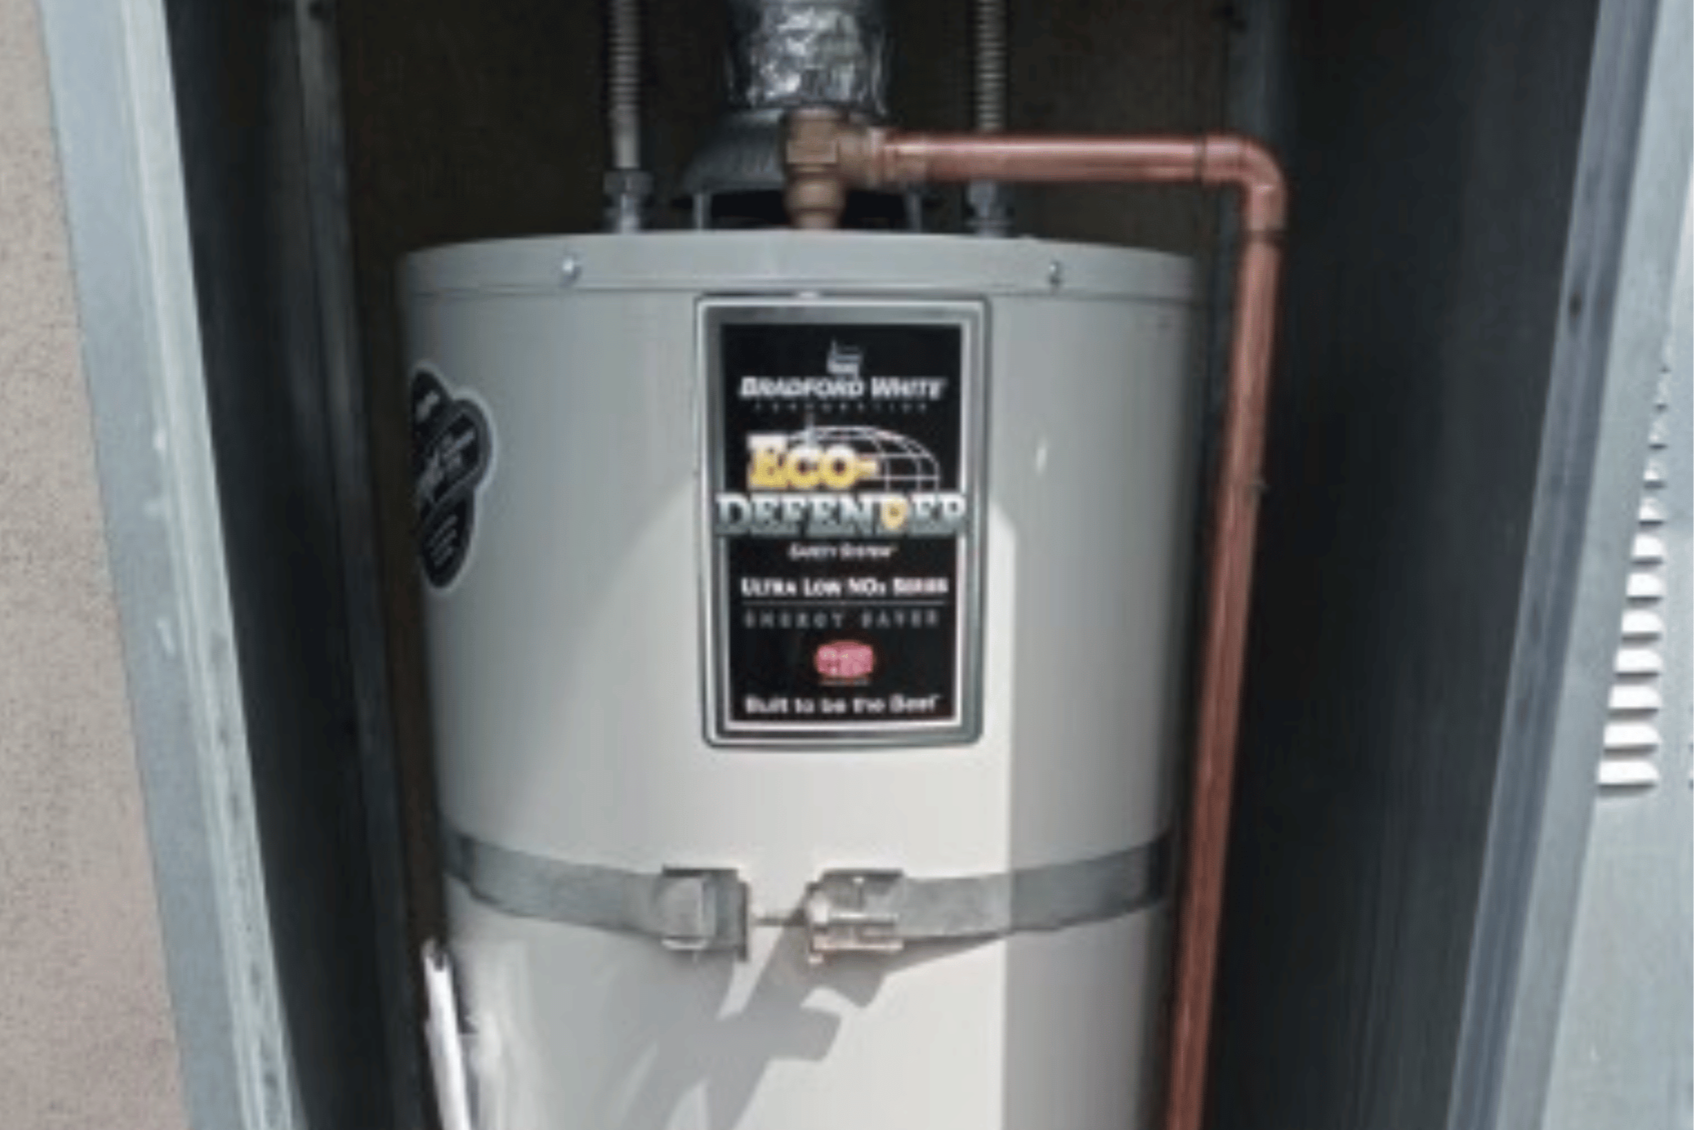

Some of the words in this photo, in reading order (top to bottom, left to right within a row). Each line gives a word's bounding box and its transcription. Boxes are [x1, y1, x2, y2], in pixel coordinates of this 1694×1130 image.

[738, 376, 865, 399] BRADFORD
[871, 377, 945, 400] WHITE
[715, 493, 967, 537] DEFENDER
[741, 577, 797, 597] ULTRA
